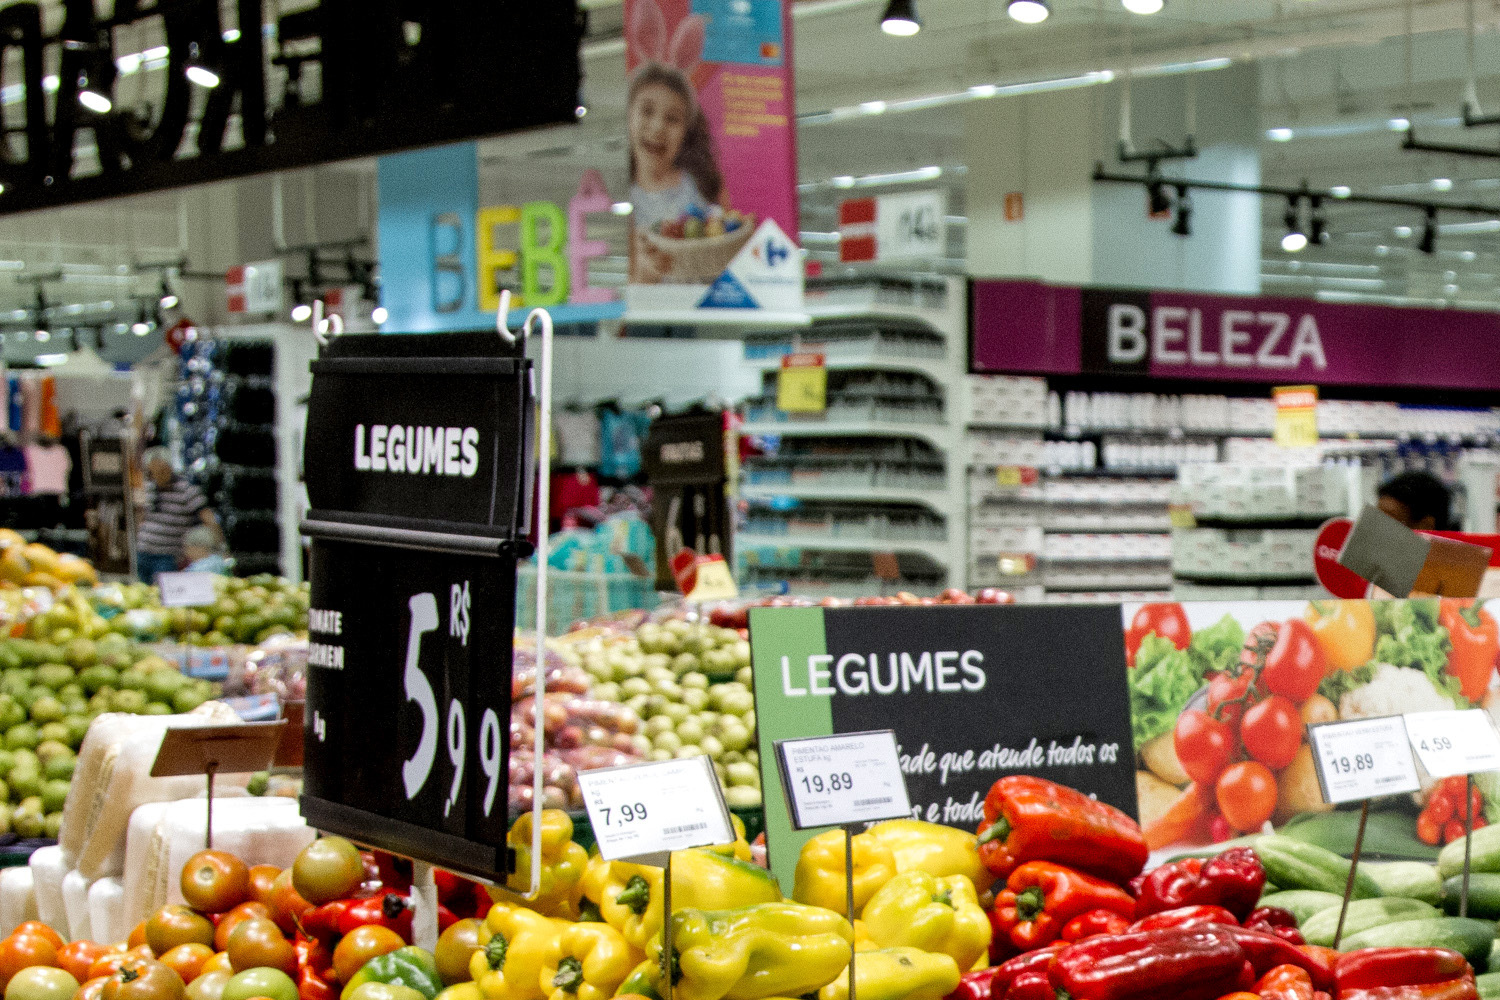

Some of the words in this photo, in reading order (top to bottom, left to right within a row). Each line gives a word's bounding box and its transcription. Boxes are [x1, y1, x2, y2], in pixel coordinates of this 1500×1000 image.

[429, 168, 617, 314] BEBÊ
[1107, 303, 1327, 370] BELEZA
[354, 423, 479, 477] LEGUMES
[450, 580, 471, 647] R$
[780, 650, 987, 697] LEGUMES
[939, 750, 976, 785] que
[977, 737, 1045, 770] atende
[1047, 735, 1097, 767] todos
[1098, 742, 1120, 764] os
[1331, 753, 1374, 774] 19,89
[1420, 736, 1452, 752] 4,59
[801, 772, 853, 795] 19,89
[599, 802, 648, 827] 7,99
[926, 802, 940, 824] e
